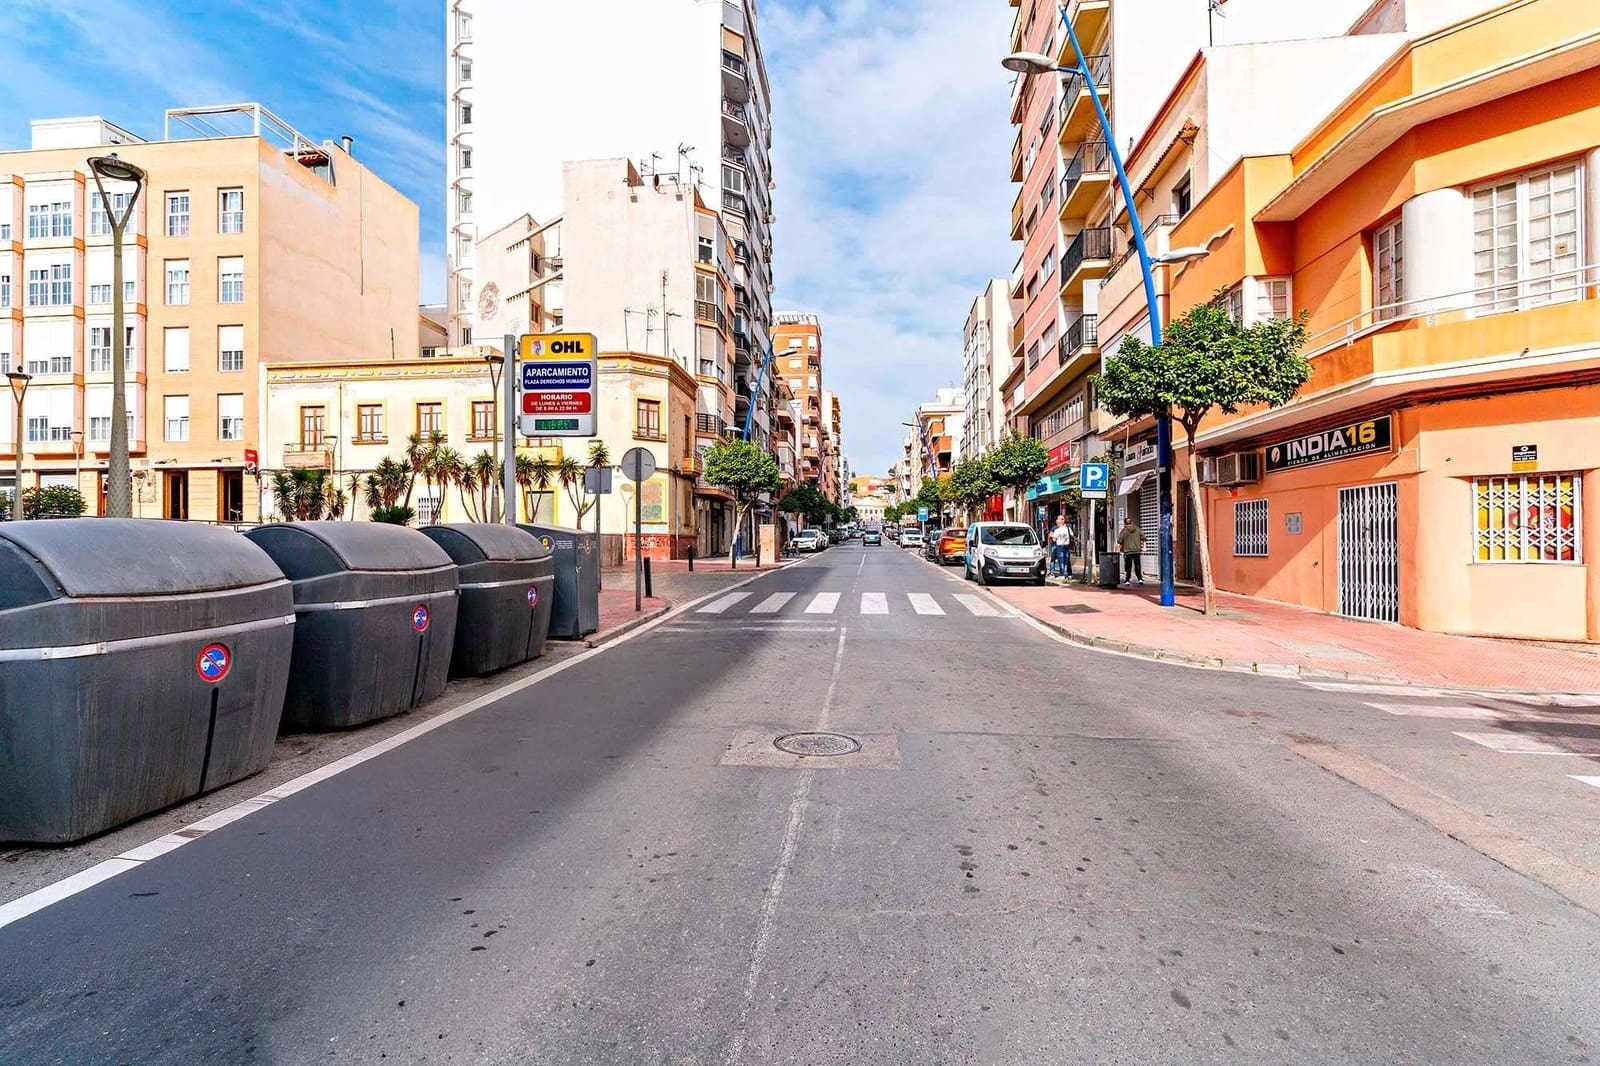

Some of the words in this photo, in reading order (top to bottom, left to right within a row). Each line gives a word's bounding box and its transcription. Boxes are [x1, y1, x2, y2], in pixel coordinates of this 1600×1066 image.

[550, 341, 584, 353] OHL
[526, 368, 589, 376] APARCAMIENTO
[1086, 466, 1103, 487] P
